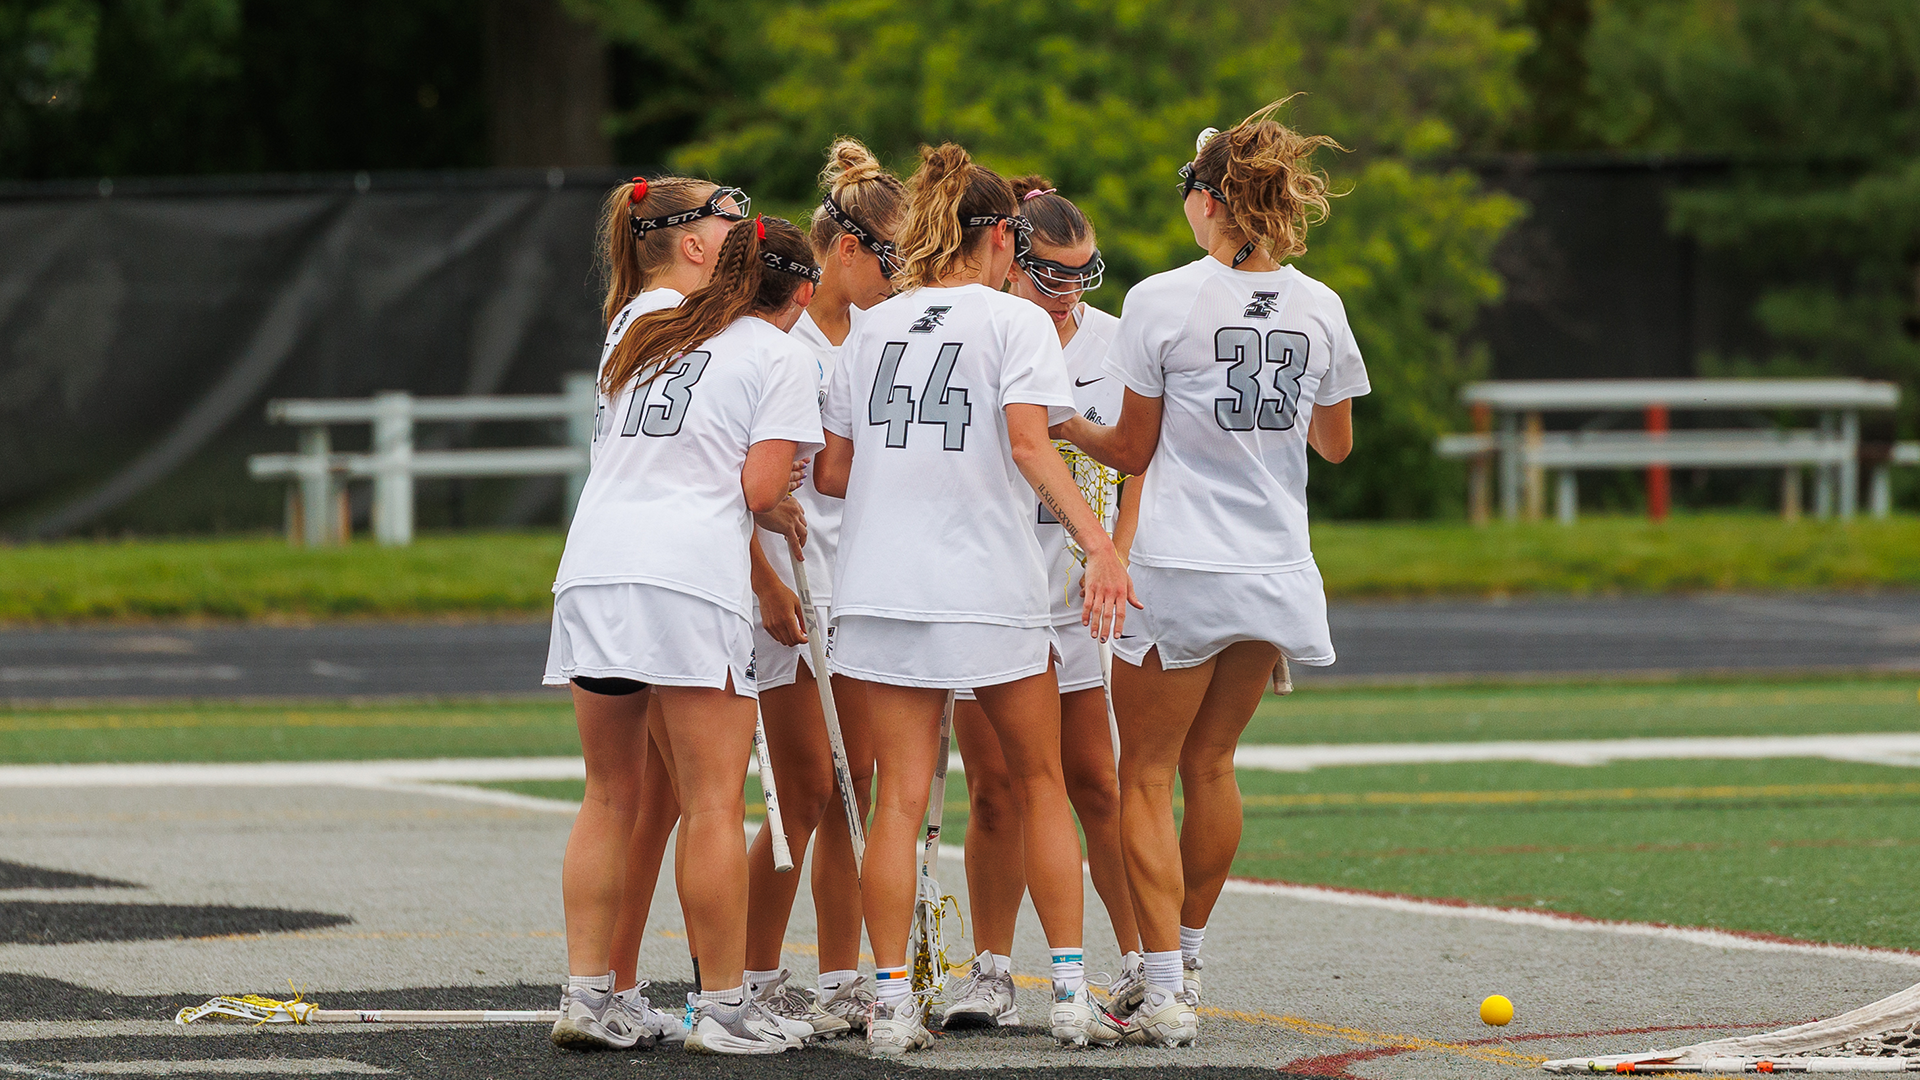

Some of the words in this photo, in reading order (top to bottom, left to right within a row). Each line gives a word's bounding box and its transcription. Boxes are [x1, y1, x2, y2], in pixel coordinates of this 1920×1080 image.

[667, 209, 702, 226] STX
[824, 200, 840, 218] STX
[641, 219, 657, 229] TX
[842, 219, 867, 240] STX
[969, 215, 999, 226] STX
[789, 261, 810, 276] STX
[1214, 326, 1310, 431] 33
[621, 350, 712, 438] 13
[868, 341, 972, 451] 44
